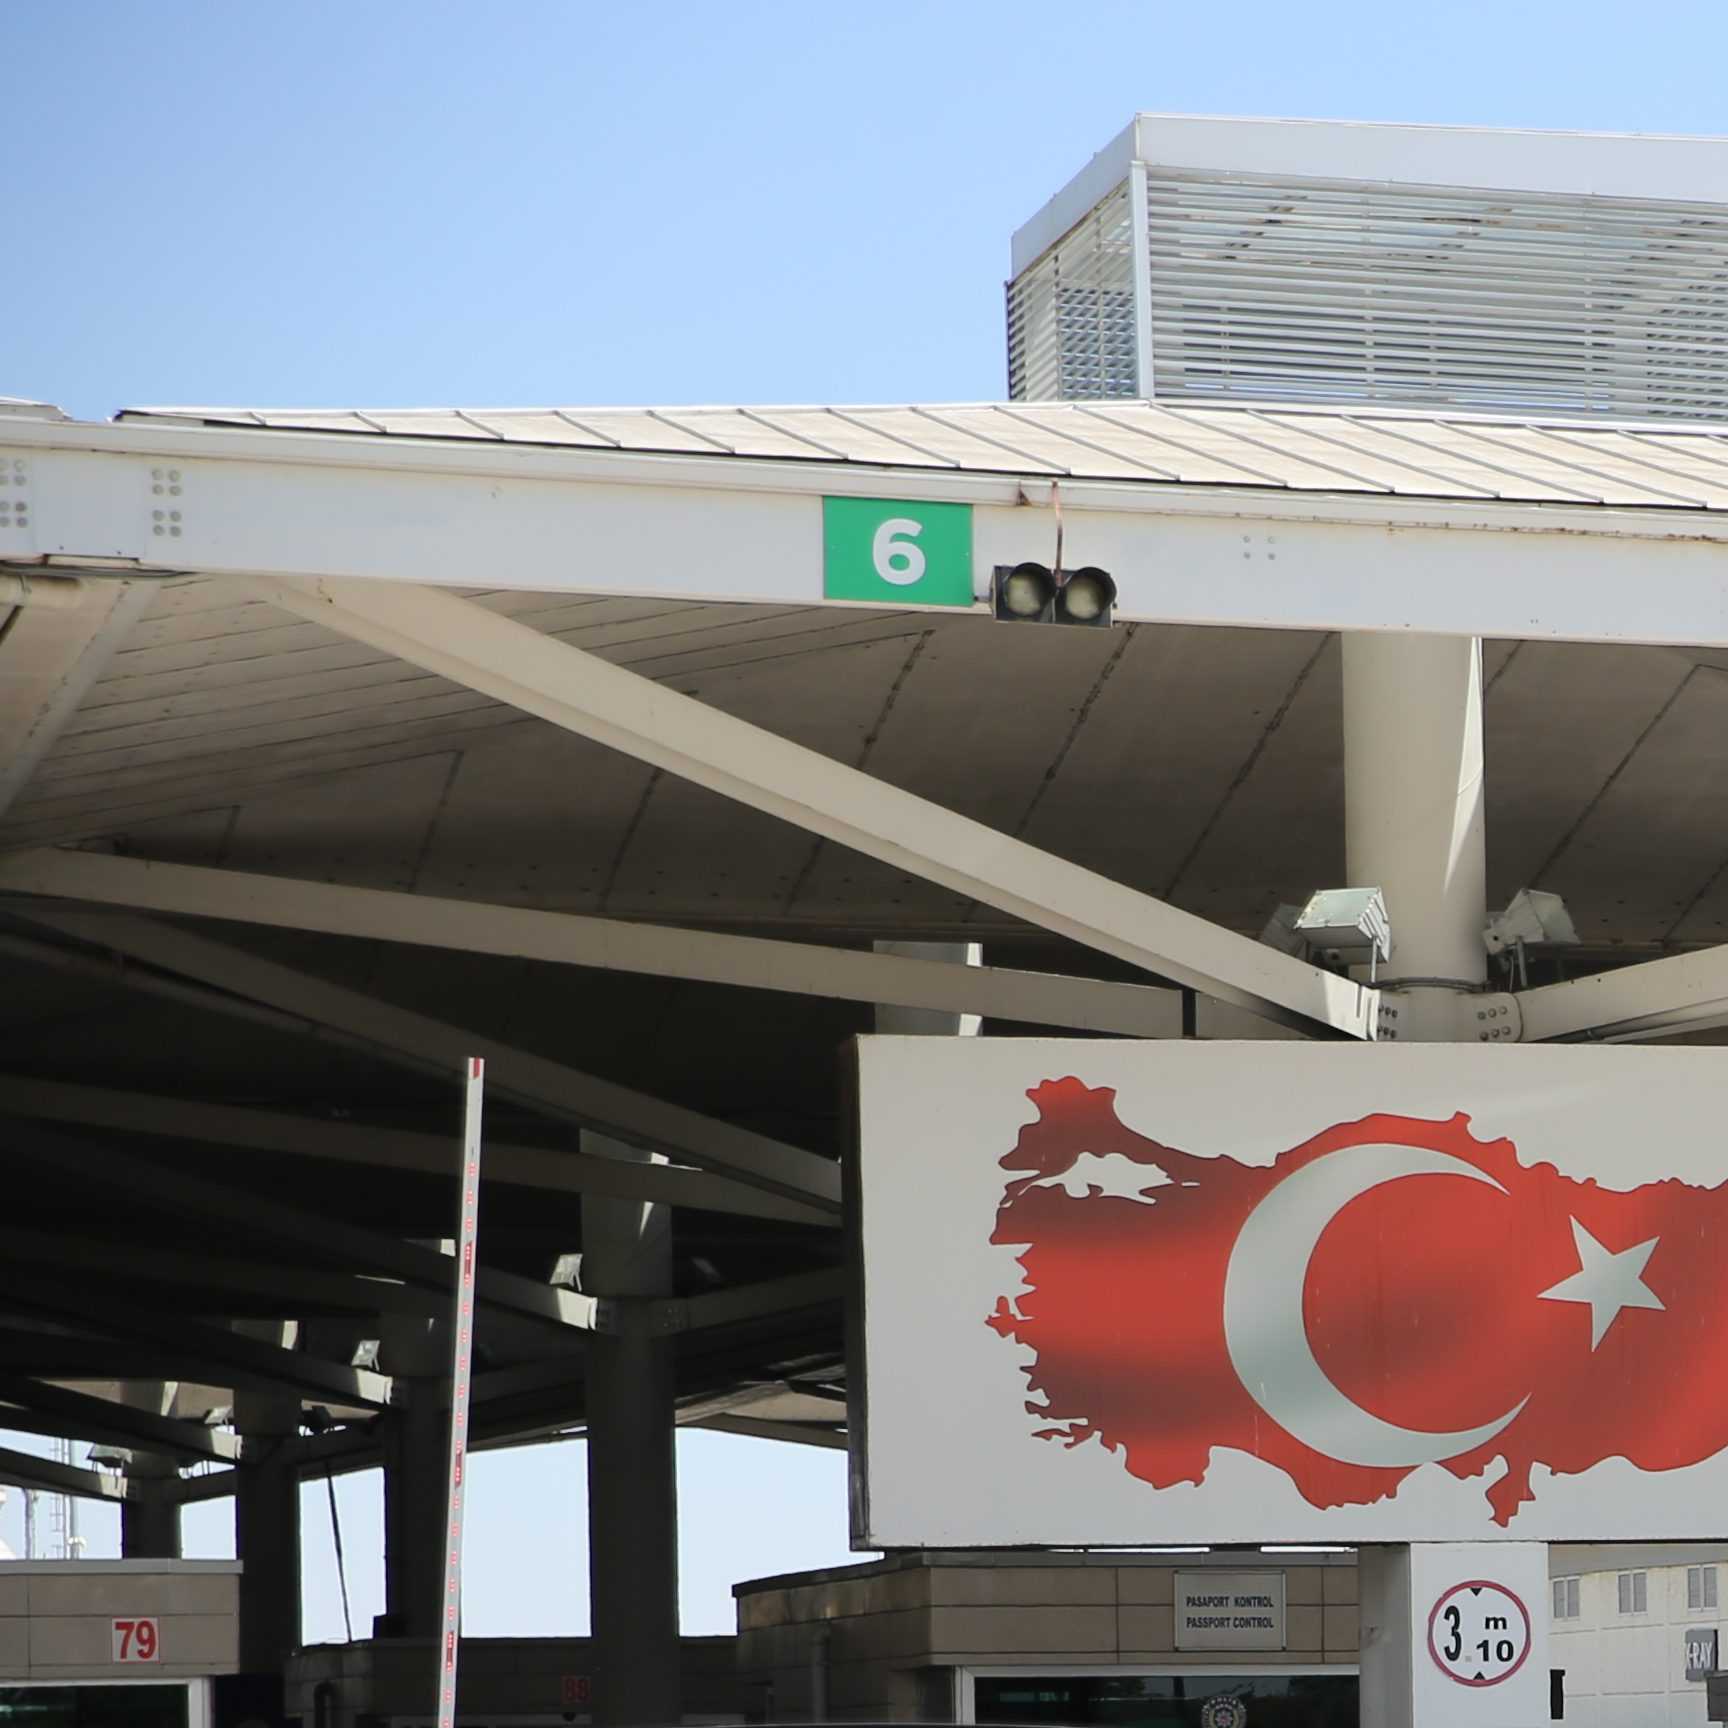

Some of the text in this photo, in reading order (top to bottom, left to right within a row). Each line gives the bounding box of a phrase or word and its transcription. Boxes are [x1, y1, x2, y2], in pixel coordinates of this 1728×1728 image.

[872, 518, 926, 585] 6
[1186, 1595, 1274, 1608] PASAPORT KONTROL
[1186, 1616, 1274, 1628] PASSPORT CONTROL
[1485, 1616, 1507, 1630] m
[115, 1620, 156, 1660] 79
